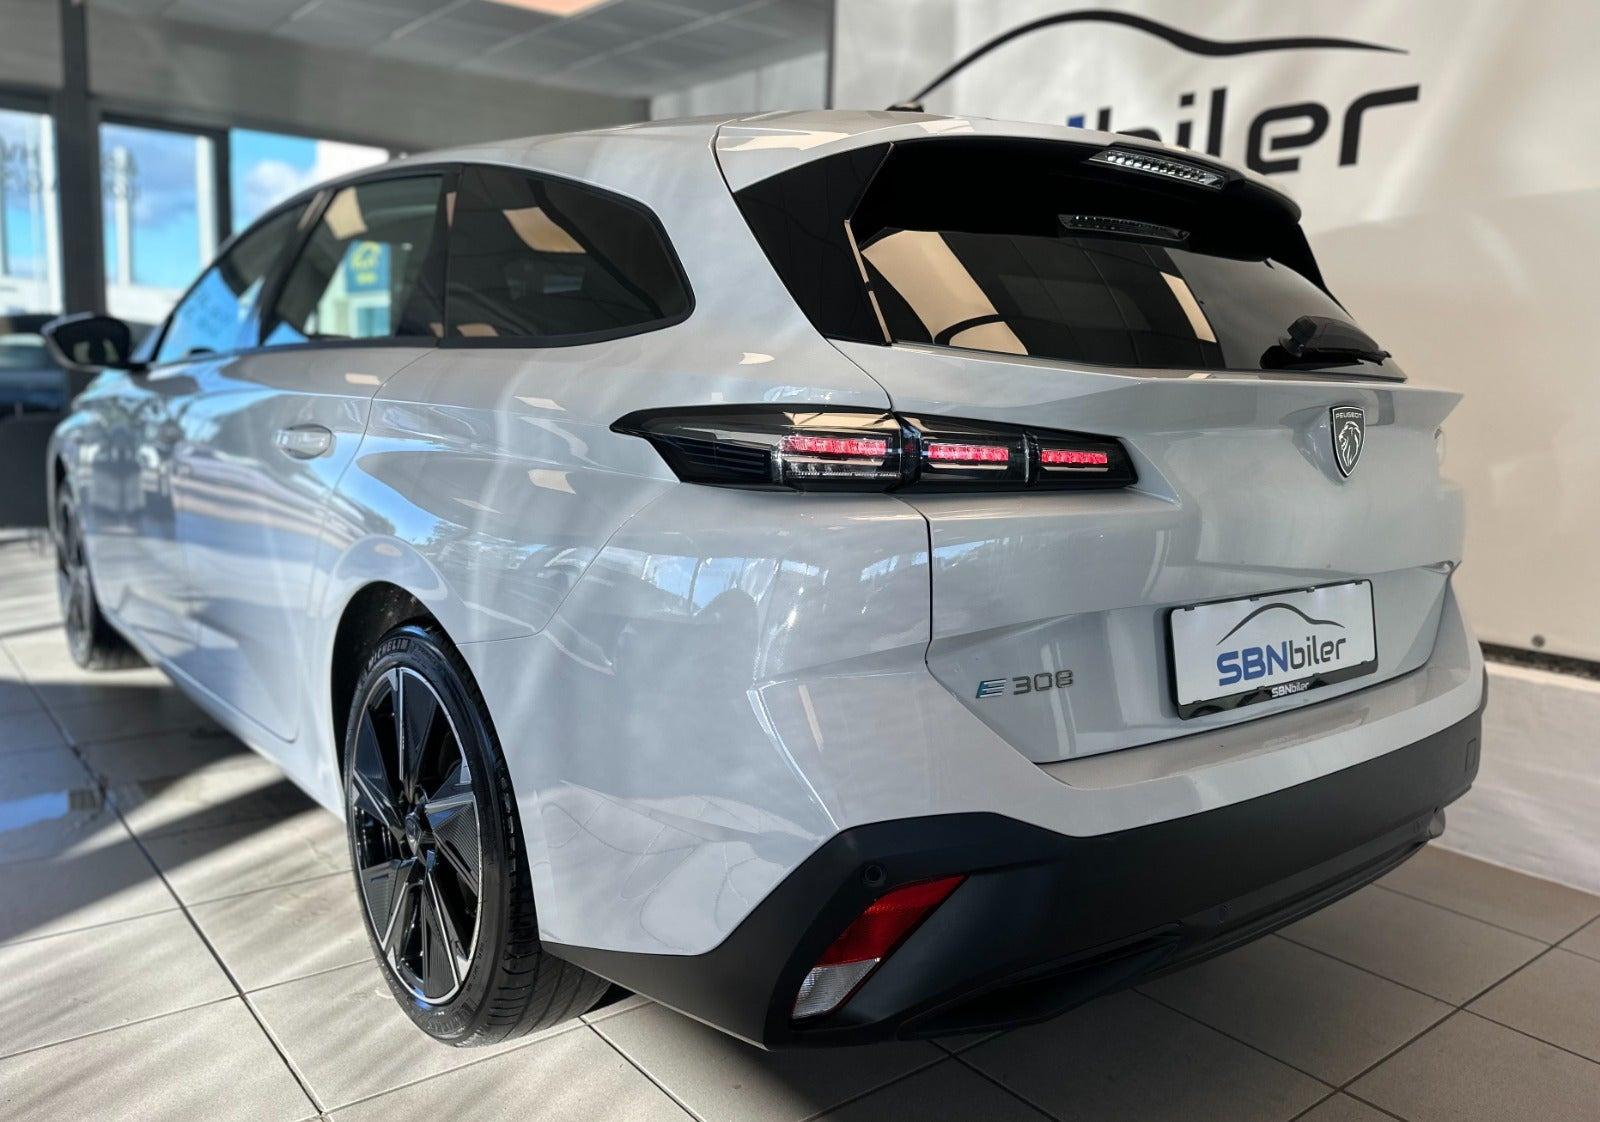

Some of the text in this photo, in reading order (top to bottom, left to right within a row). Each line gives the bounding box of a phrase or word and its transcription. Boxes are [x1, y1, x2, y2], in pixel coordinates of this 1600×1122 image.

[1335, 411, 1363, 420] PEUGEOT
[1216, 635, 1347, 687] SBNbiler
[976, 669, 1074, 699] E 308
[1271, 681, 1310, 699] SBNbiler
